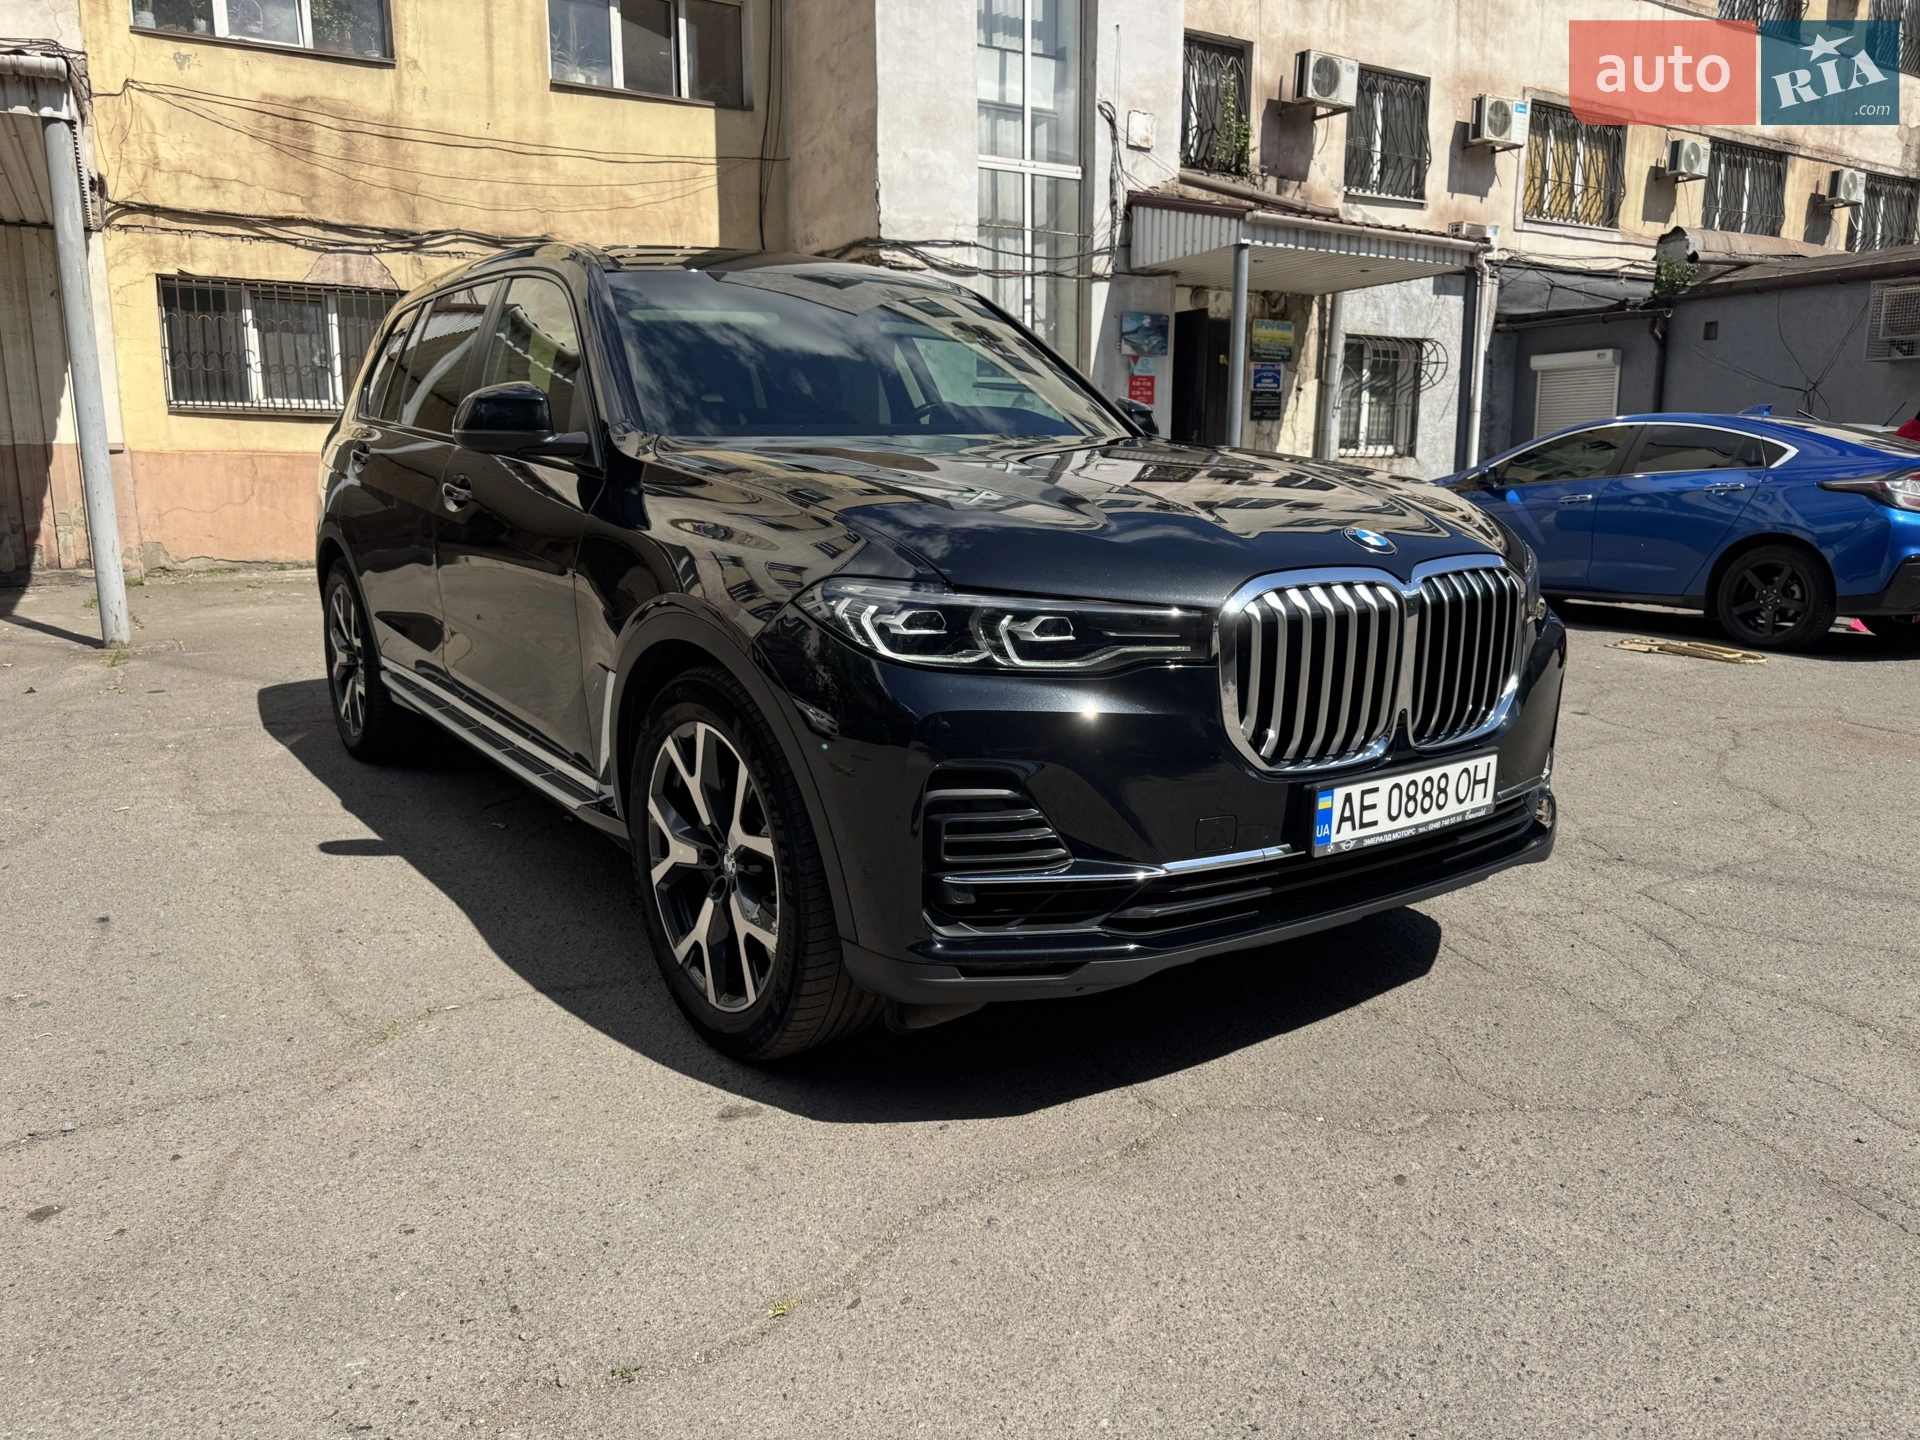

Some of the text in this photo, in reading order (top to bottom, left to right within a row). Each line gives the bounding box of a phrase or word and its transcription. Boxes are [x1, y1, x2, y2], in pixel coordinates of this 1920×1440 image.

[1336, 762, 1491, 835] AE 0888 OH
[1465, 807, 1487, 820] Emerald
[752, 757, 793, 899] MICHELIN
[1316, 824, 1330, 837] UA
[1363, 833, 1392, 846] ЭМЕРАЛД
[1392, 827, 1416, 839] МОТОРС
